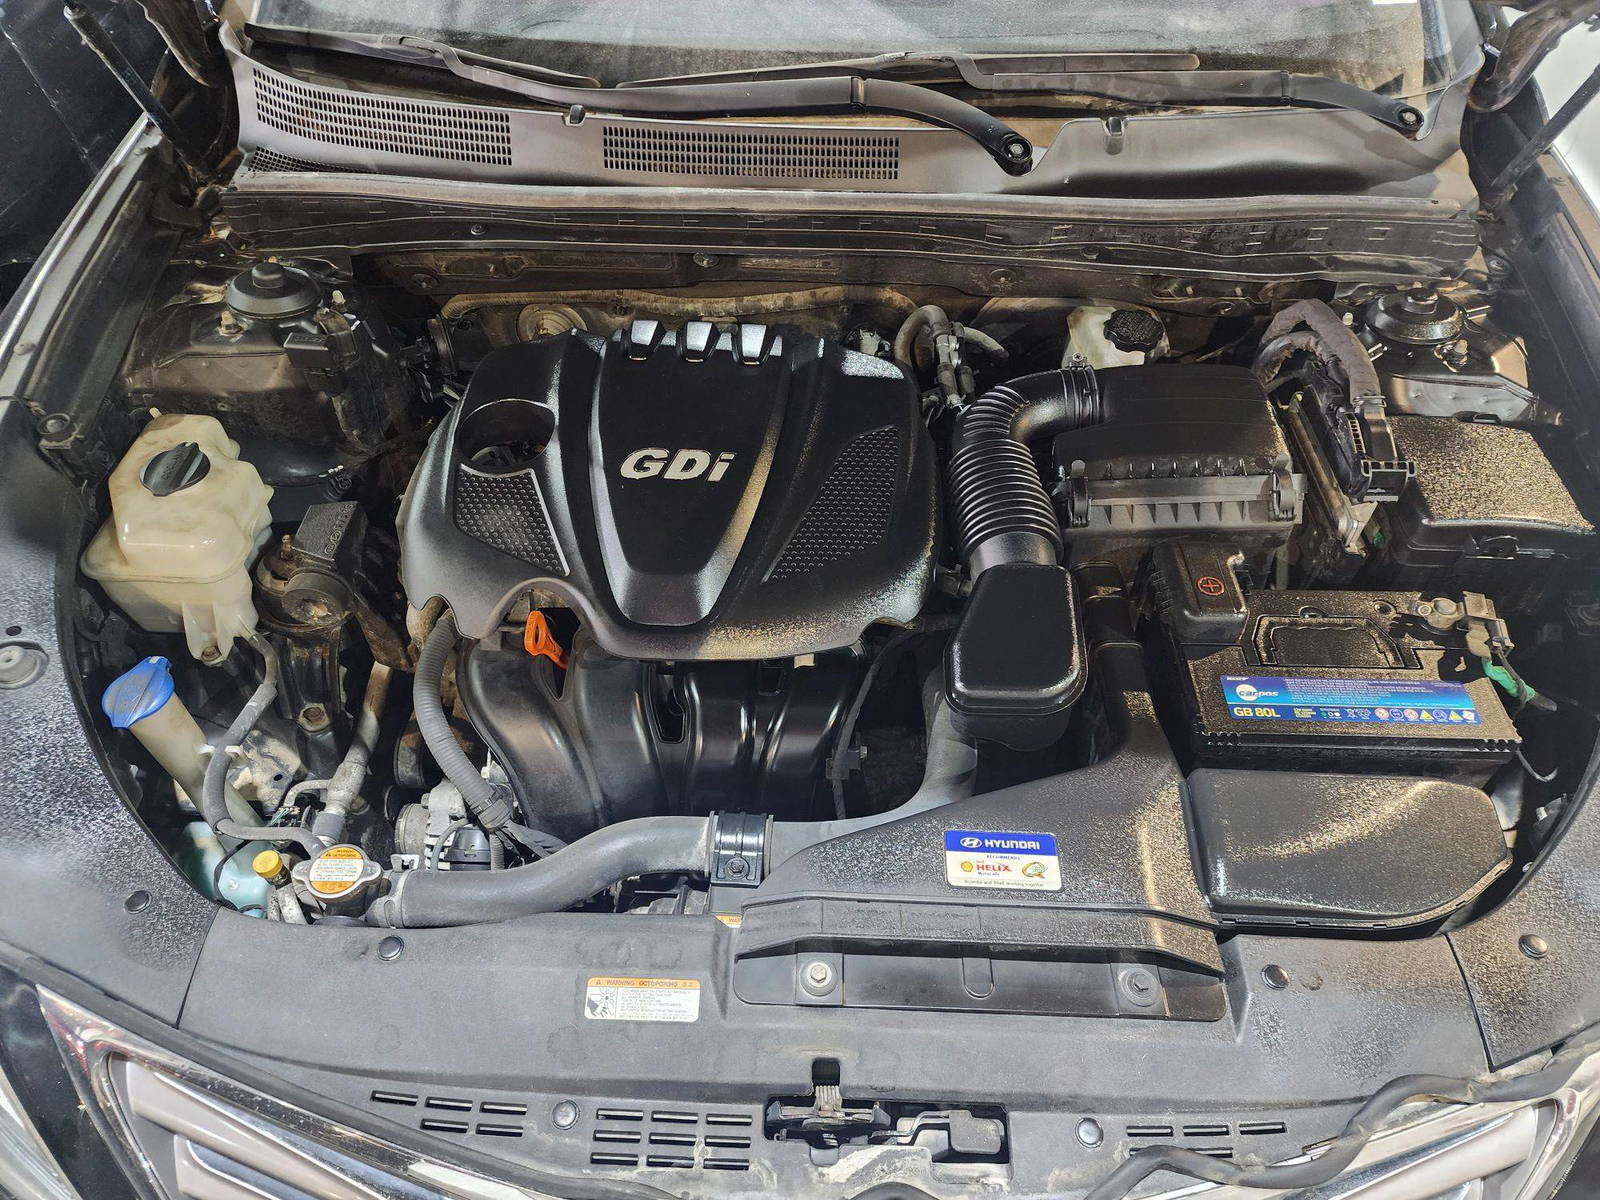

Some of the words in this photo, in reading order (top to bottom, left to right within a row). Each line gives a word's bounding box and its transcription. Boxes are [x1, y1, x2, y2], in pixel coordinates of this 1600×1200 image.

[620, 447, 737, 482] GDi
[1233, 706, 1254, 717] GB
[1255, 707, 1281, 718] 80L
[984, 839, 1041, 851] HYUNDAI
[976, 864, 1012, 873] HELIX
